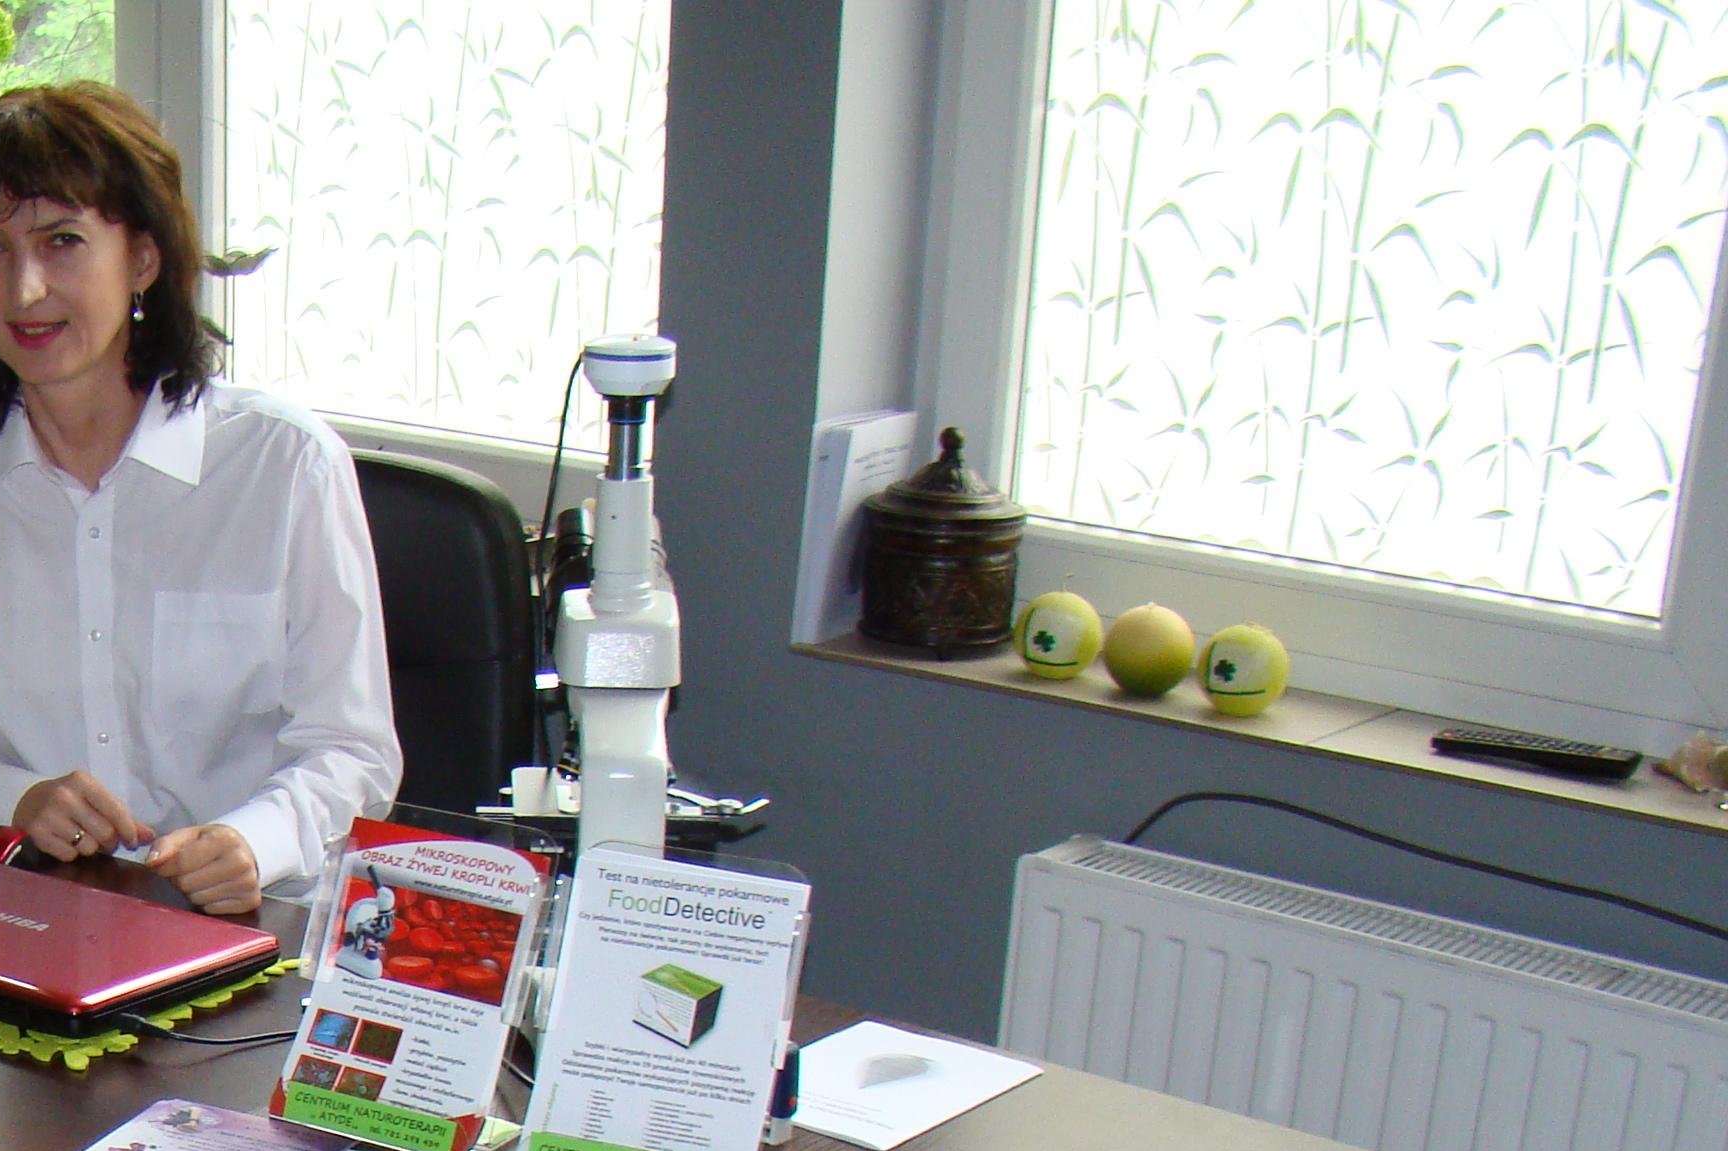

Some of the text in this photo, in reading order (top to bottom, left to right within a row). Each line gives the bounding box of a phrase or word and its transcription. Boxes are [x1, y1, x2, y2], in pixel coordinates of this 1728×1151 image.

[361, 850, 531, 896] OBRAZ ŻYWEJ KROPLI KRWI
[415, 846, 515, 875] MIKROSKOPOWY
[598, 867, 790, 906] Test na nietolerancje pokarmowe
[295, 1090, 351, 1113] CENTRUM
[354, 1105, 447, 1137] NATUROTERAPII
